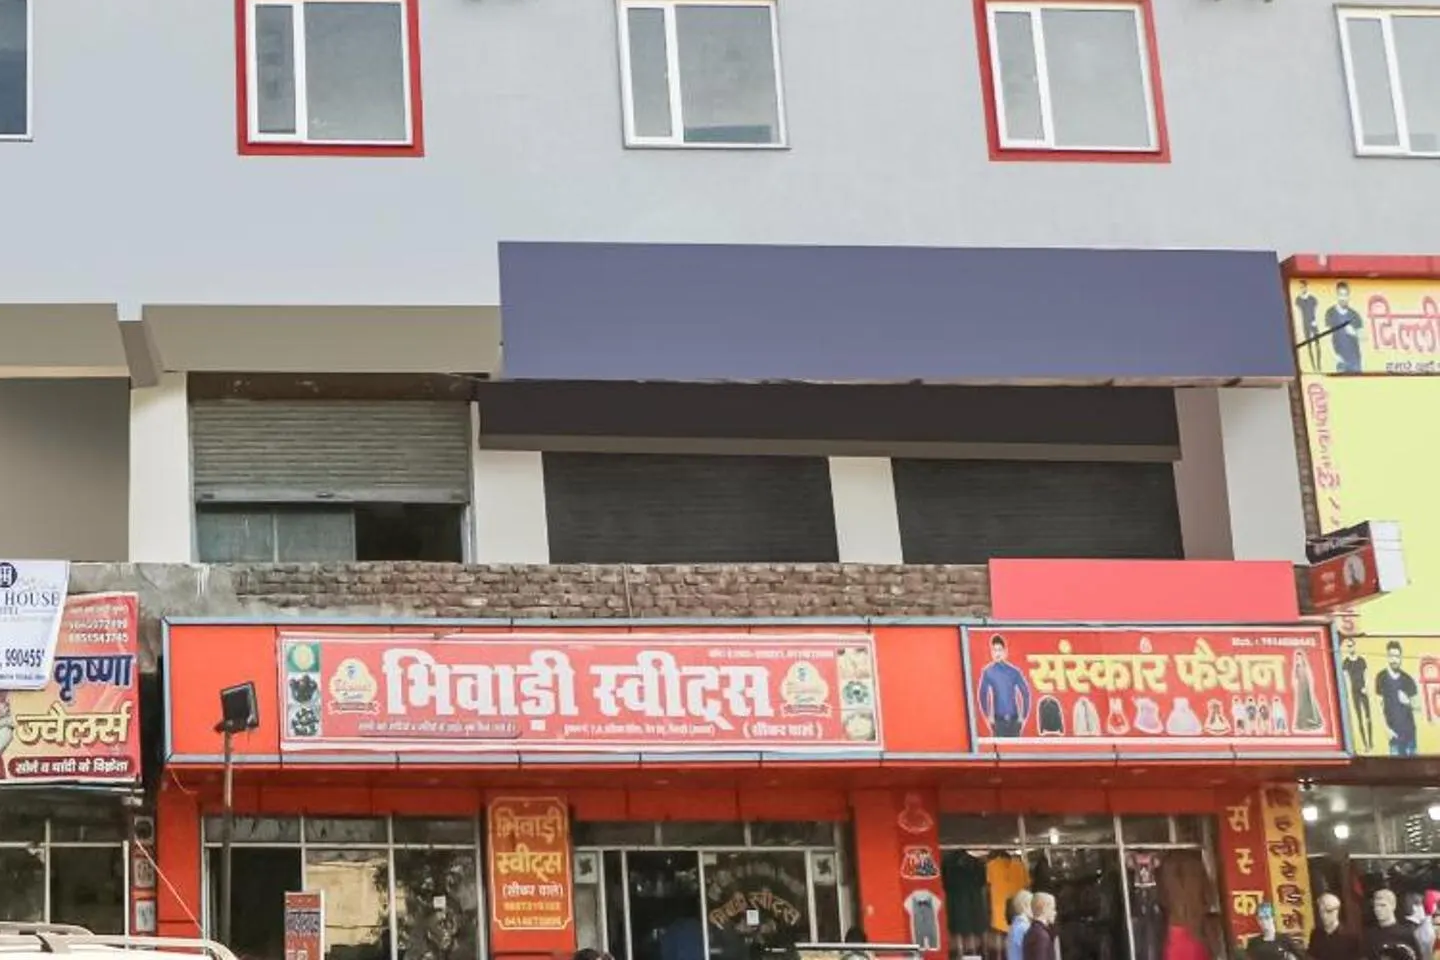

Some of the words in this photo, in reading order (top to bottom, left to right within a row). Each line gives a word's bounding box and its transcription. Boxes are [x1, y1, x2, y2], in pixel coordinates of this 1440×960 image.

[4, 591, 60, 606] HOUSE
[54, 655, 133, 702] कृष्णा
[1173, 638, 1287, 693] फैशन
[382, 648, 578, 731] भिवाड़ी
[589, 651, 775, 730] स्वीट्स
[495, 843, 563, 882] स्वीट्स
